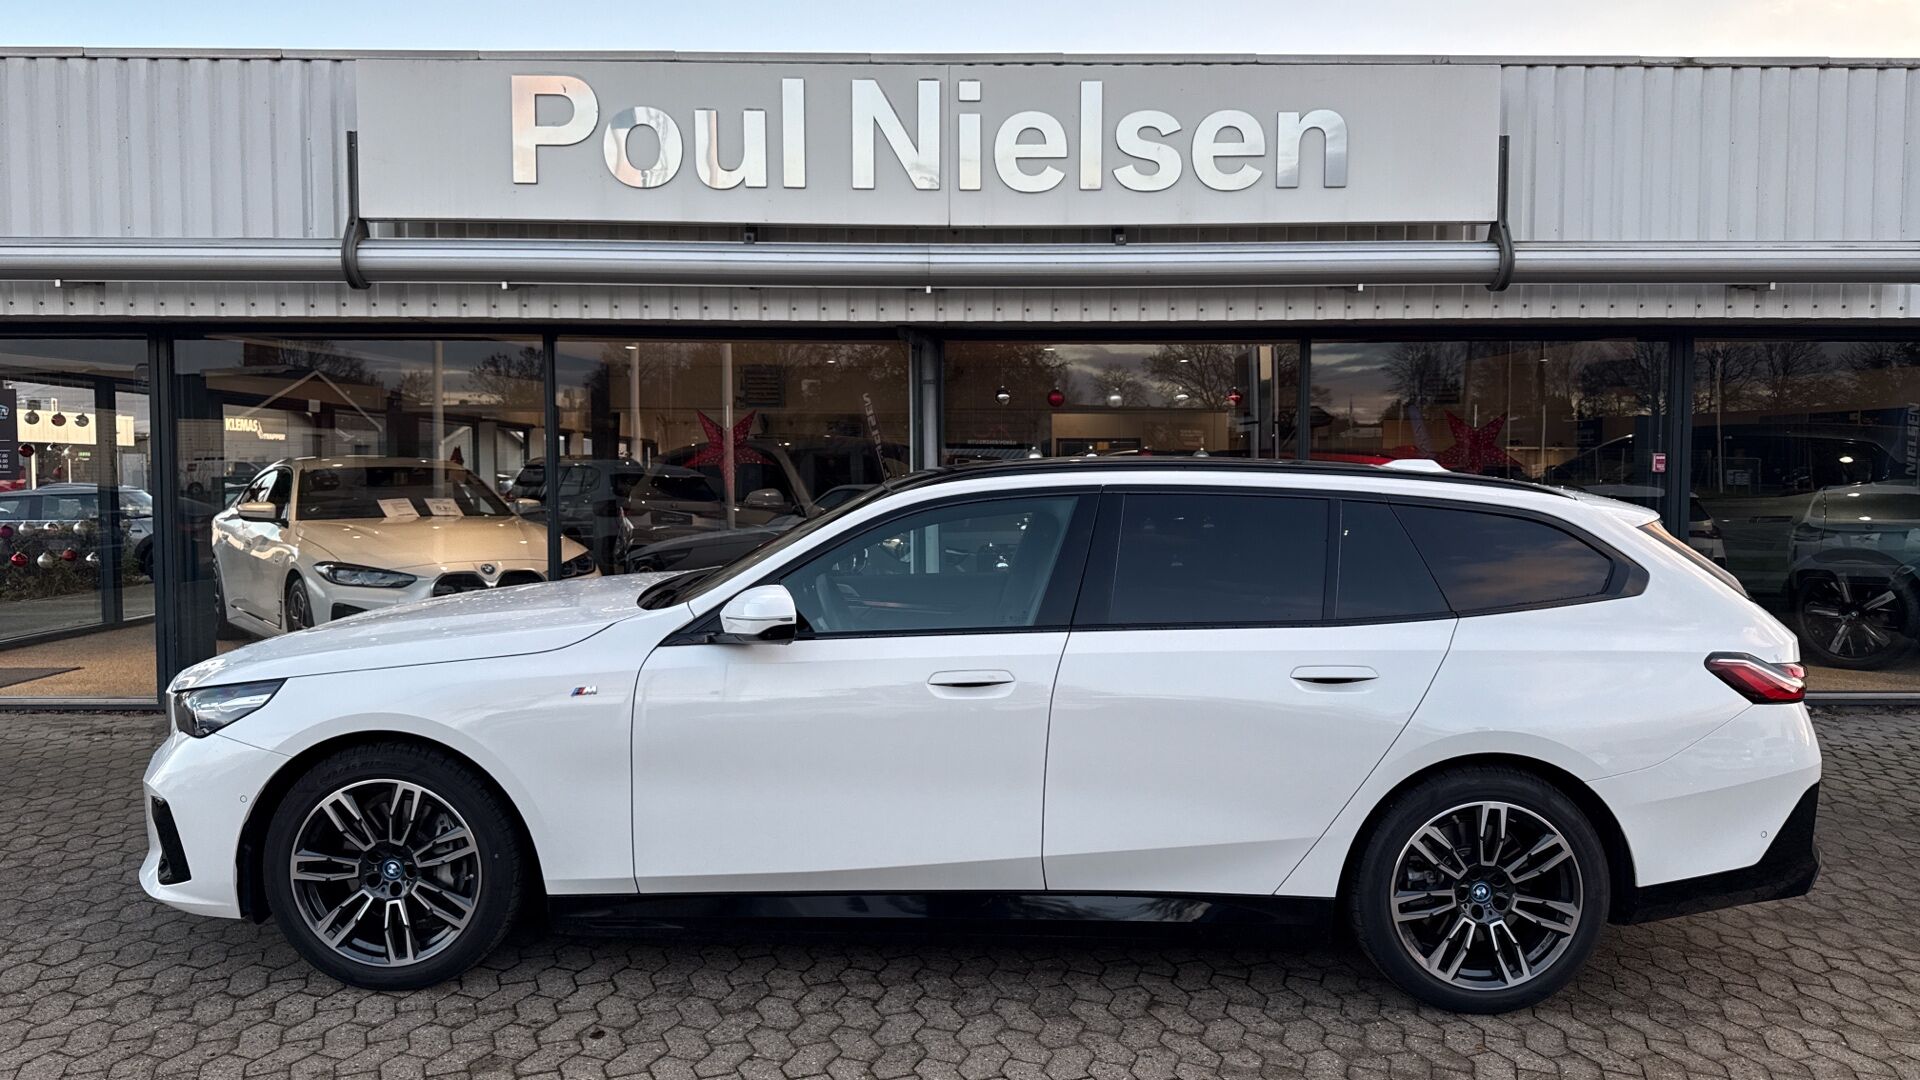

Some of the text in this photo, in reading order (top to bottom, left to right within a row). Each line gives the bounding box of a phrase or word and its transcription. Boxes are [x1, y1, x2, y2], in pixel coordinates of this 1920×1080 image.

[511, 74, 1348, 193] Poul Nielsen
[225, 418, 258, 431] KLEMAS
